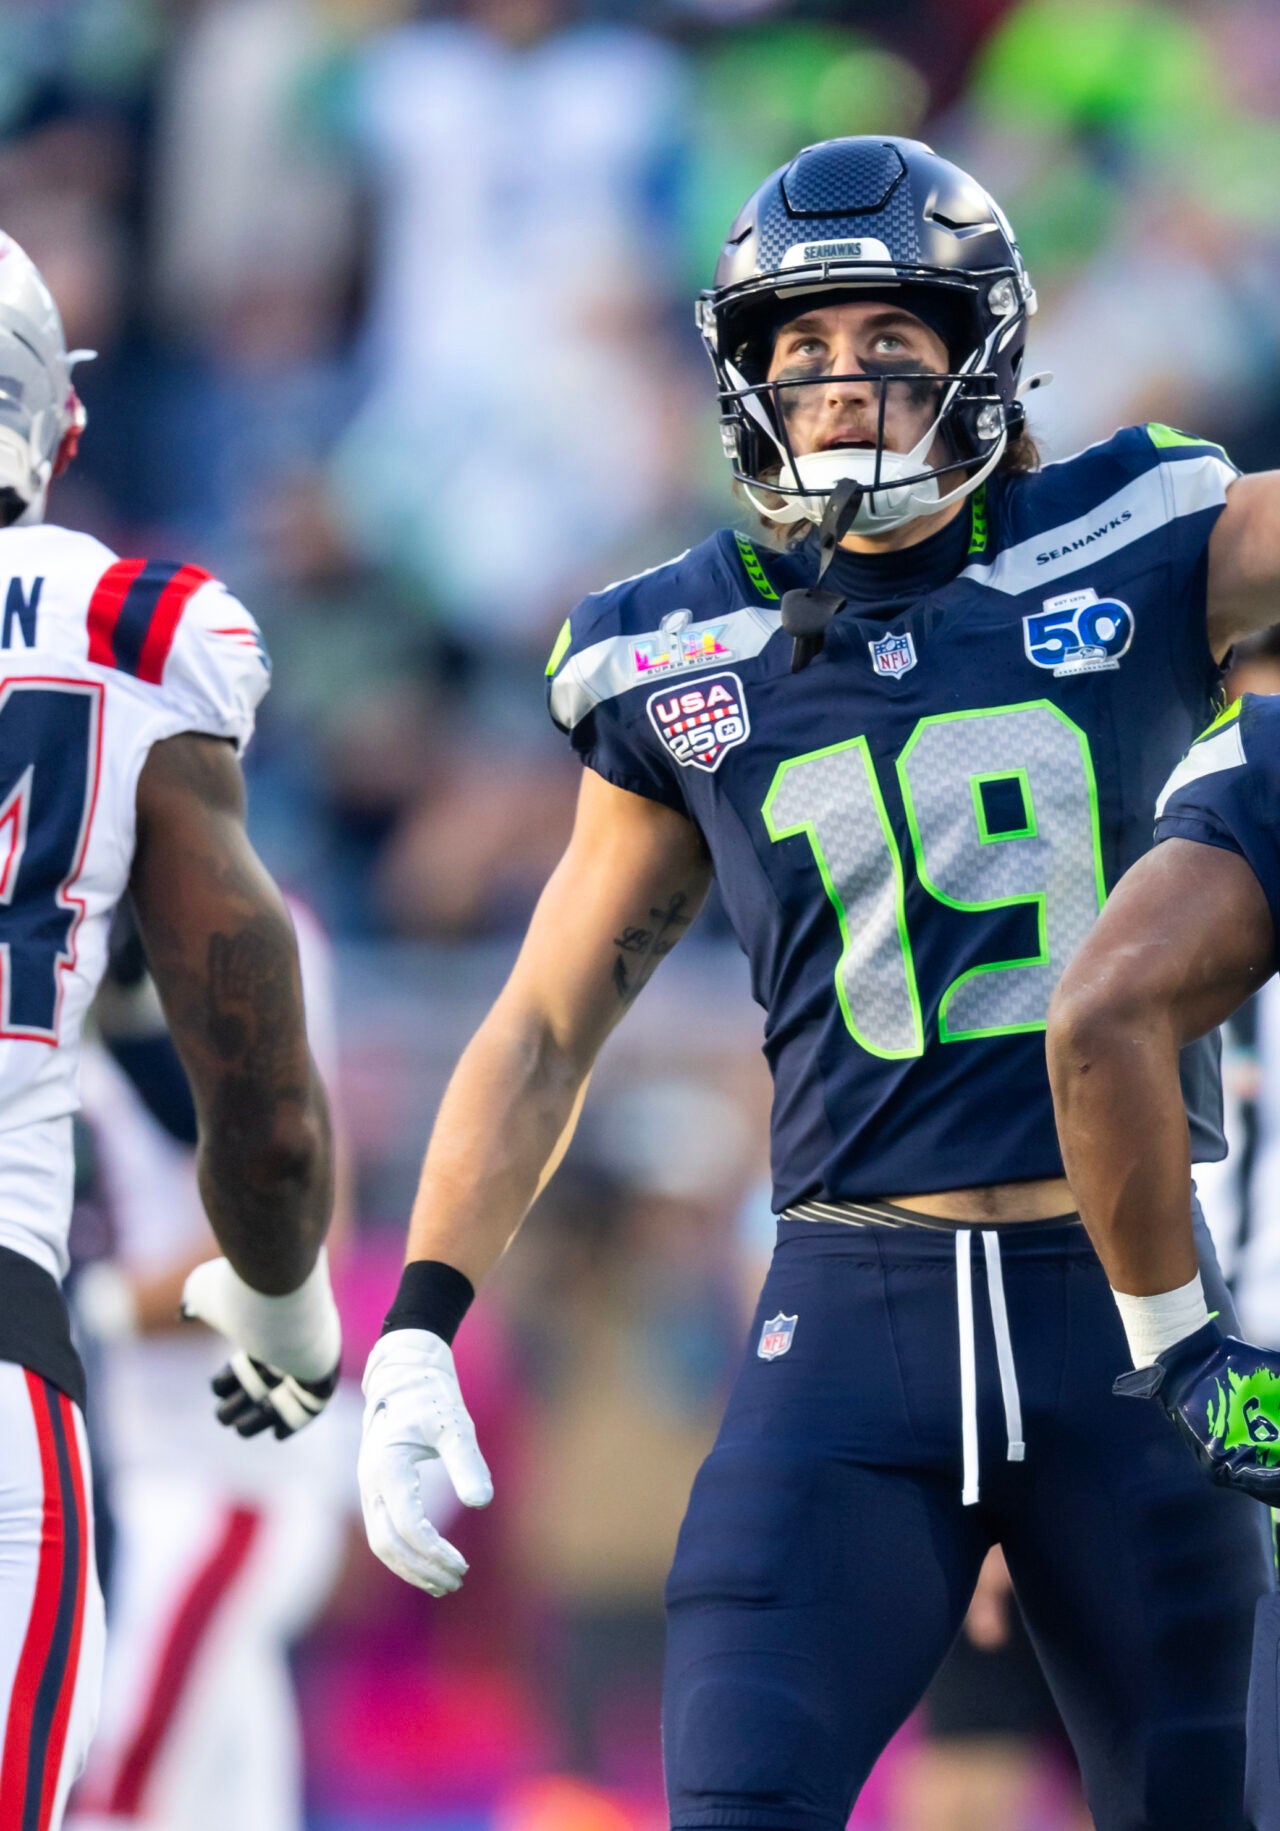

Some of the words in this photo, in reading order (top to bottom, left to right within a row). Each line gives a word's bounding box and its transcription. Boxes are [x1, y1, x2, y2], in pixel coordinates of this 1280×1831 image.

[804, 243, 861, 260] SEAHAWKS
[1035, 510, 1132, 566] SEAHAWKS
[1027, 602, 1130, 664] 50
[647, 661, 684, 675] SUPER
[689, 655, 721, 665] BOWL
[880, 650, 909, 669] NFL
[656, 684, 734, 723] USA
[669, 716, 743, 760] 250
[761, 698, 1107, 1059] 19
